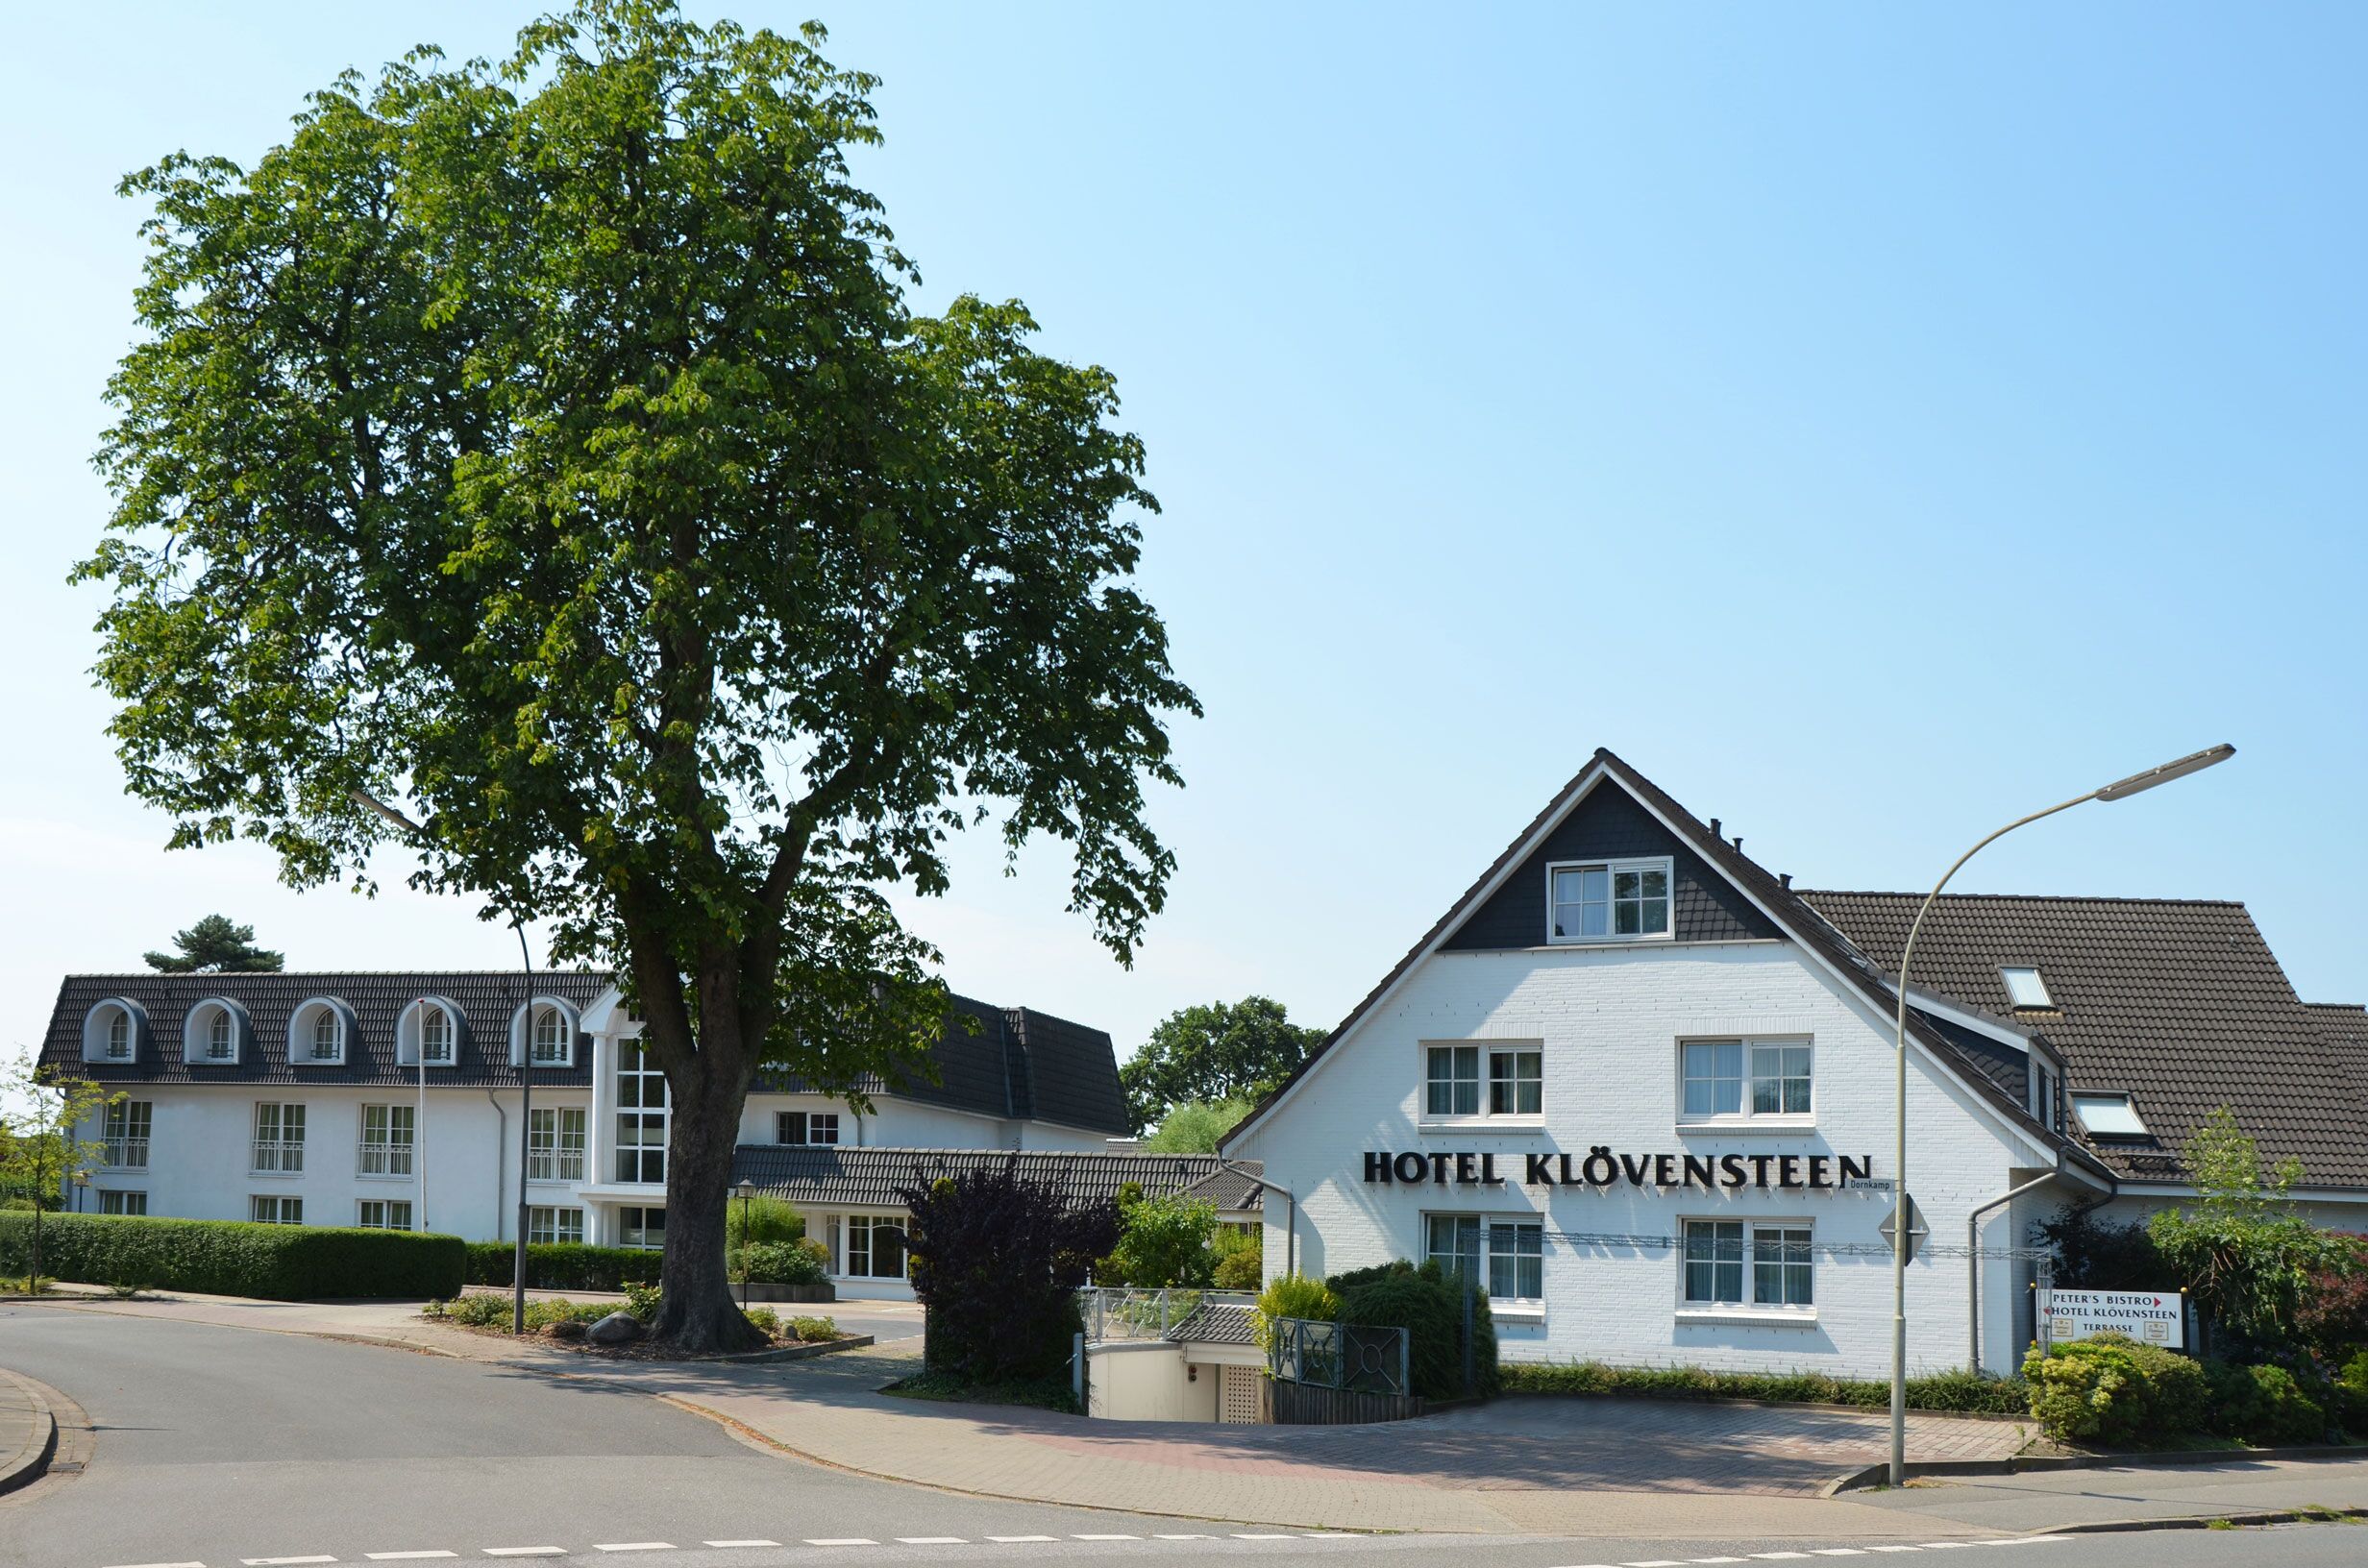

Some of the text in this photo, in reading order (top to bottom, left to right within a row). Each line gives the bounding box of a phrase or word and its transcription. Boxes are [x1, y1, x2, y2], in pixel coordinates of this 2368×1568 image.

[1364, 1145, 1872, 1190] HOTEL KLÖVENSTEEN
[1850, 1180, 1890, 1190] Dornkamp
[2053, 1294, 2152, 1306] PETER'S BISTRO
[2052, 1307, 2177, 1319] HOTEL KLÖVENSTEEN
[2083, 1323, 2134, 1333] TERRASSE
